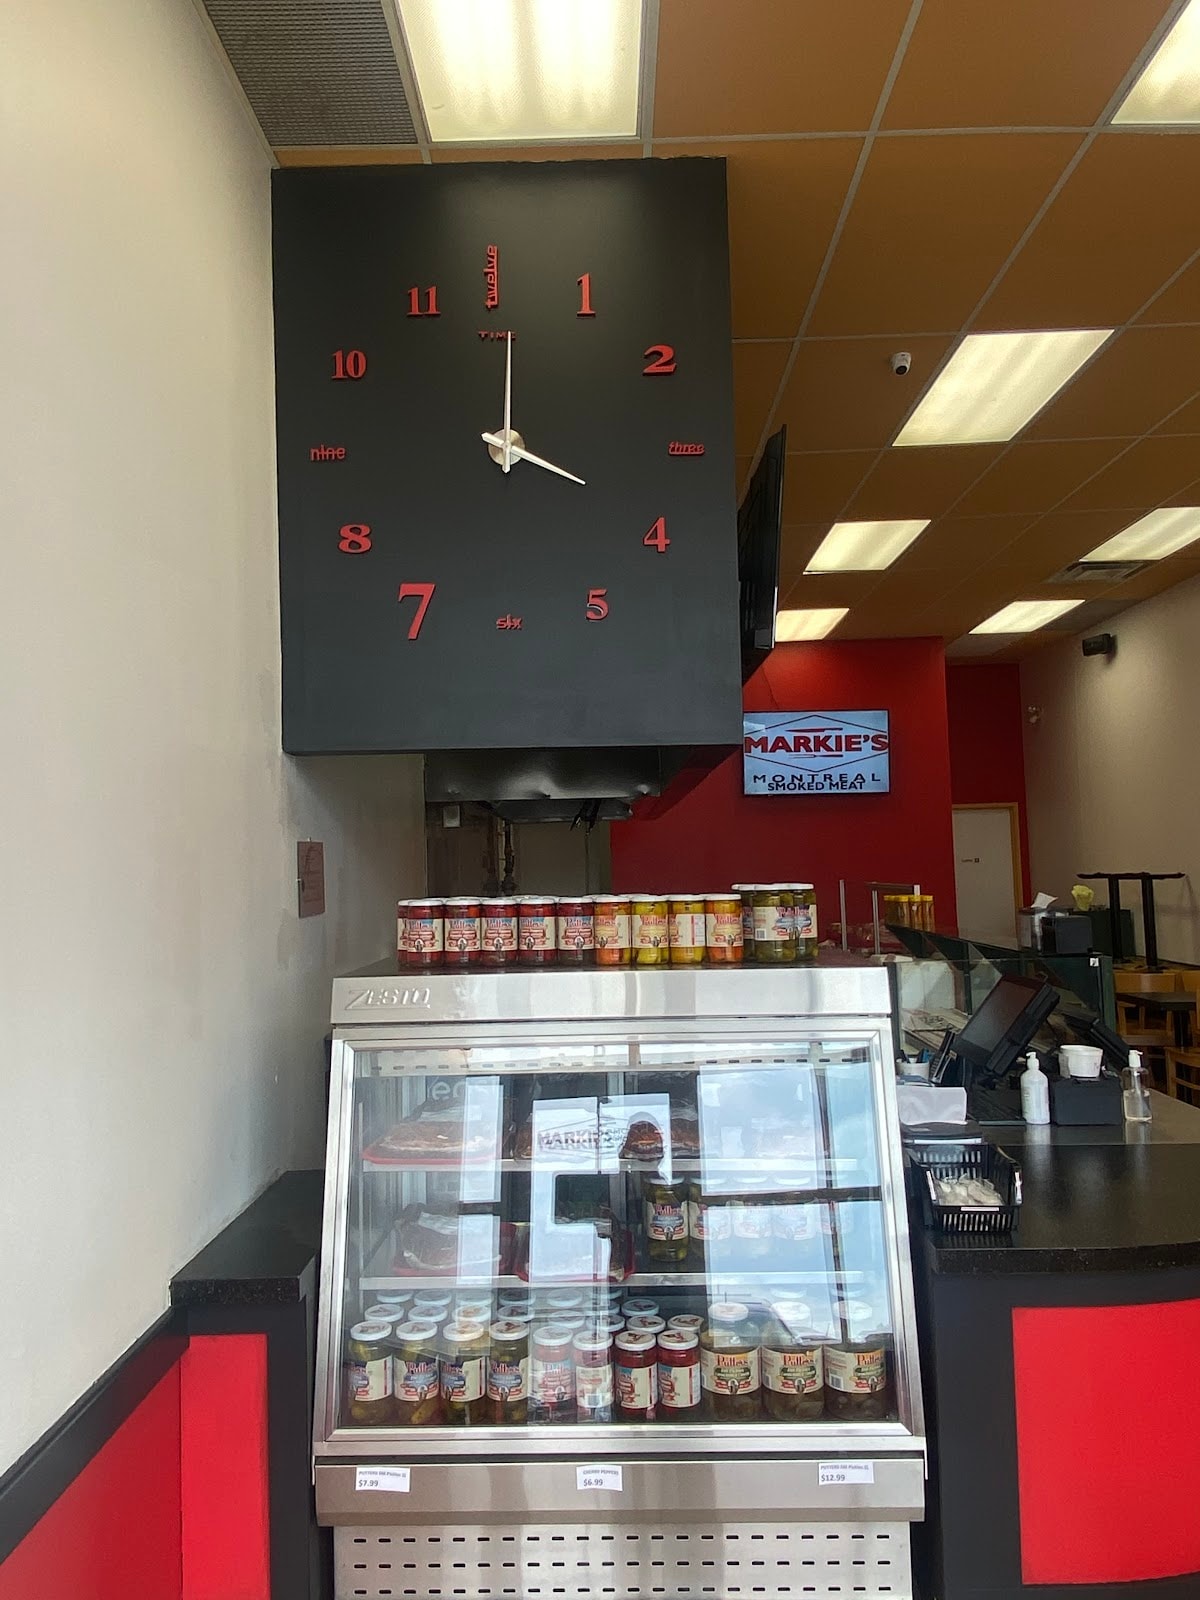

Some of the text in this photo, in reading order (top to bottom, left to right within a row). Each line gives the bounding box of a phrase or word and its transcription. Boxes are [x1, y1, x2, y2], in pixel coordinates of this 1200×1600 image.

[483, 244, 499, 309] twelve
[408, 286, 440, 317] 11
[577, 273, 595, 317] 1
[332, 349, 367, 380] 10
[643, 344, 677, 375] 2
[310, 444, 346, 461] nine
[668, 440, 706, 456] three
[338, 523, 372, 554] 8
[643, 516, 671, 553] 4
[398, 582, 436, 640] 7
[586, 587, 609, 621] 5
[496, 613, 523, 629] six
[744, 734, 889, 754] MARKIE'S
[753, 773, 881, 784] MONTREAL
[767, 781, 865, 791] SMOKED MEAT
[358, 1479, 379, 1488] $7.99
[583, 1478, 604, 1487] $6.99
[820, 1473, 846, 1482] $12.99
